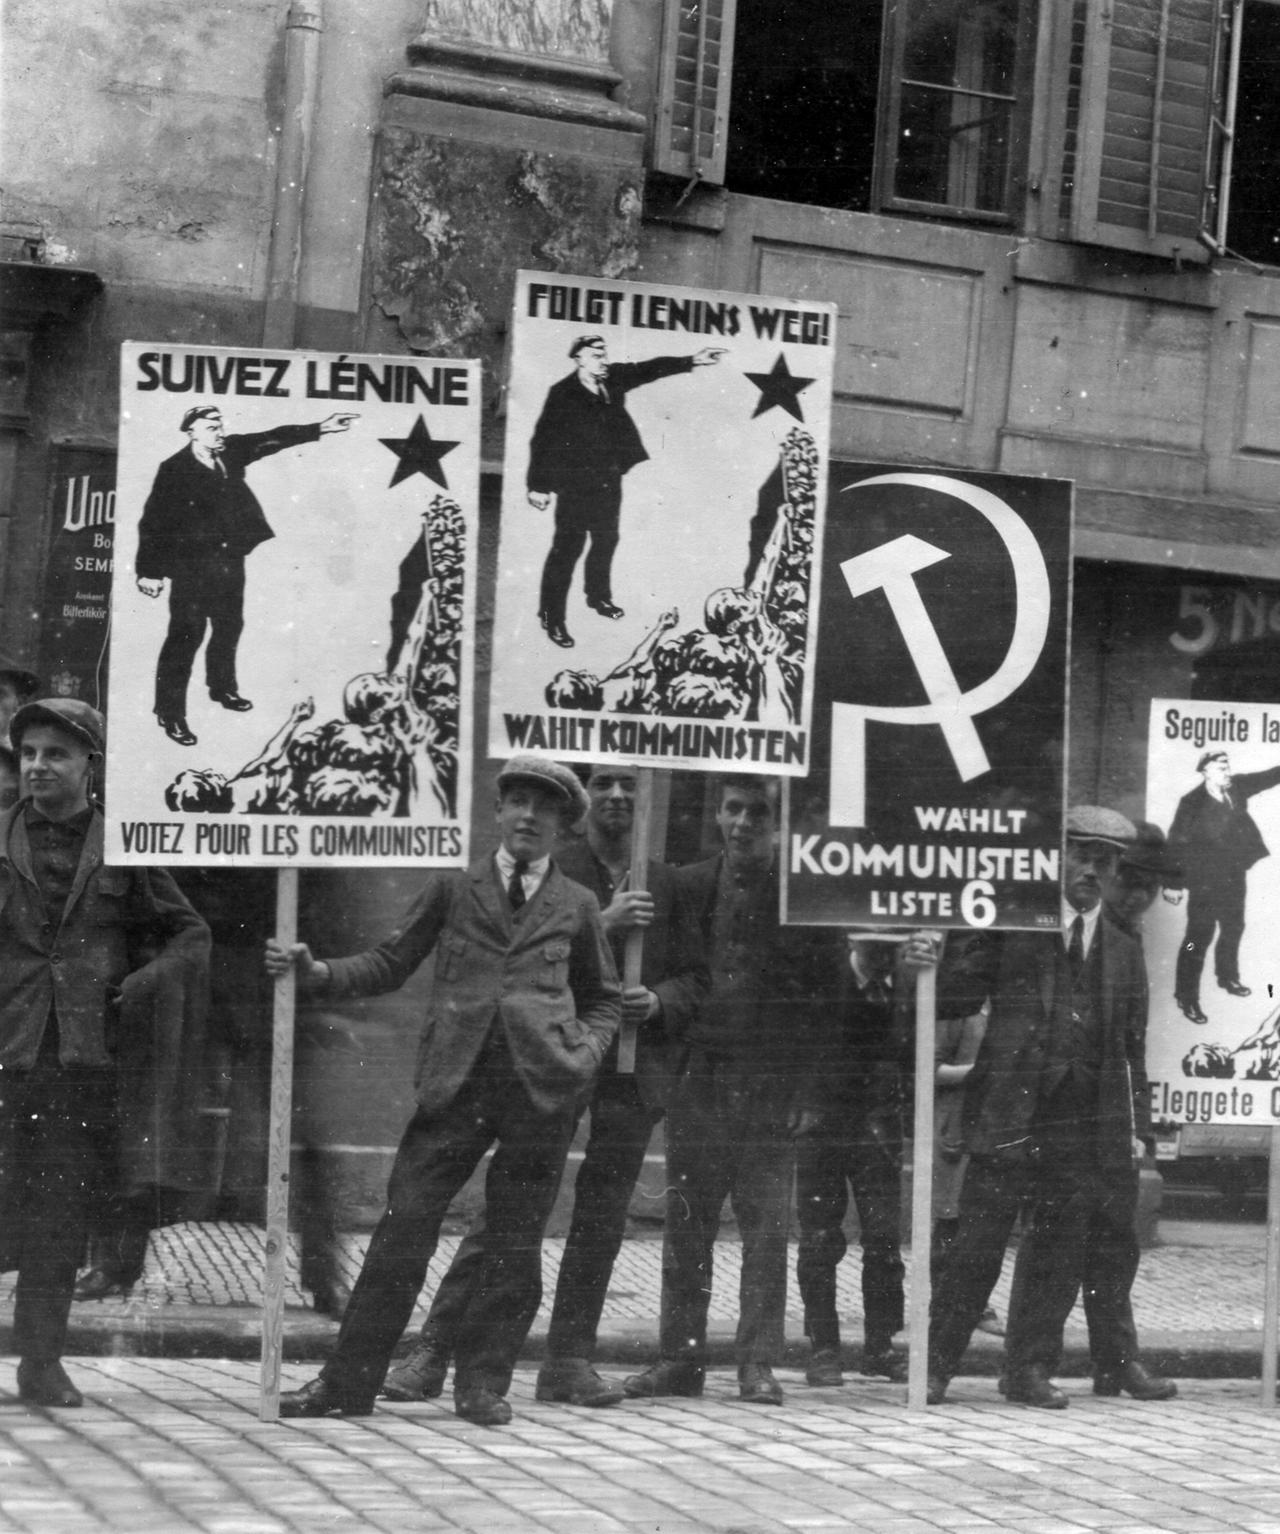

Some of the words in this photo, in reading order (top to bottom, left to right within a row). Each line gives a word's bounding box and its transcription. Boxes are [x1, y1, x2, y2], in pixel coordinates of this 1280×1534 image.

[528, 283, 624, 325] FOLGT
[631, 294, 741, 337] LENINS
[748, 305, 829, 346] WEG!
[136, 352, 292, 398] SUIVEZ
[305, 355, 469, 406] LÉNINE
[93, 533, 114, 549] Bo
[600, 719, 807, 766] KOMMUNISTEN
[1164, 708, 1250, 748] Seguite
[1262, 712, 1280, 743] la
[121, 822, 184, 854] VOTEZ
[196, 823, 250, 855] POUR
[262, 824, 300, 856] LES
[310, 825, 463, 857] COMMUNISTES
[791, 834, 1060, 881] KOMMUNISTEN
[870, 890, 952, 917] LISTE
[961, 880, 997, 928] 6
[1150, 1081, 1254, 1123] Eleggete
